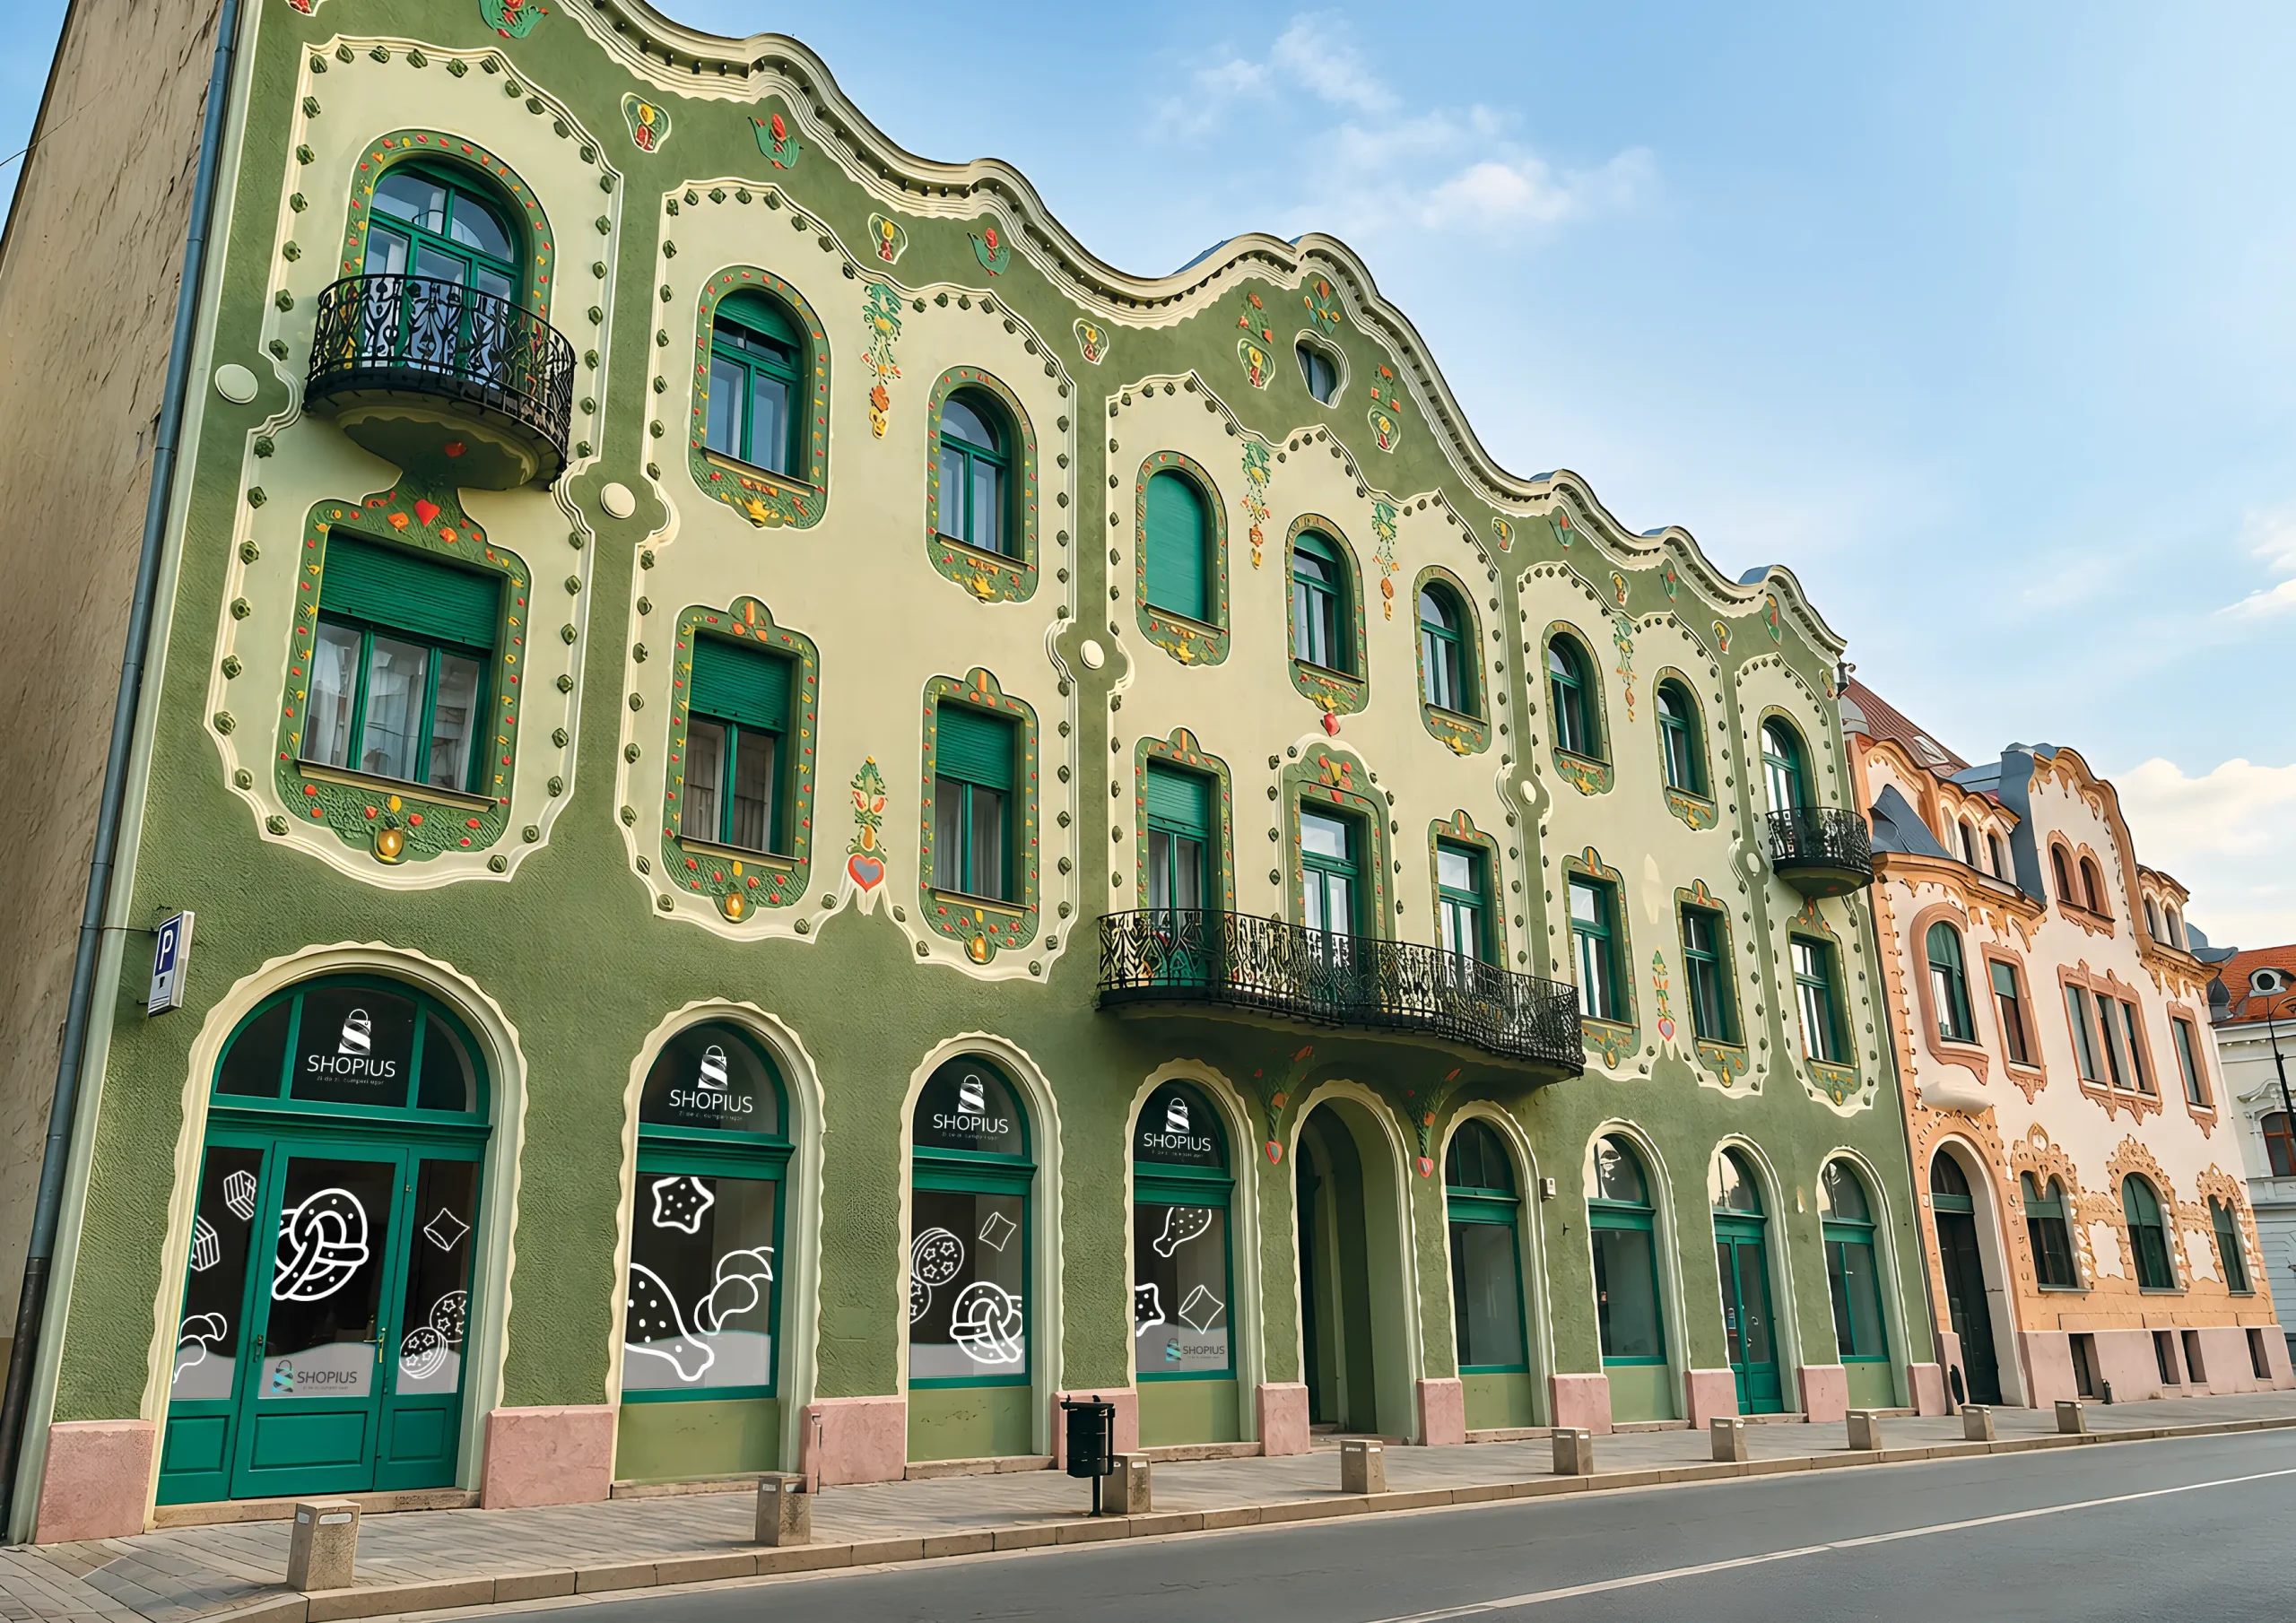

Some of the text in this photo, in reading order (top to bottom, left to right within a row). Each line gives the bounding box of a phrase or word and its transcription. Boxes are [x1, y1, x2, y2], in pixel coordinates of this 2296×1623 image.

[159, 929, 174, 970] P
[307, 1055, 396, 1078] SHOPIUS
[668, 1089, 753, 1113] SHOPIUS
[933, 1114, 1009, 1133] SHOPIUS
[1144, 1133, 1212, 1151] SHOPIUS
[1182, 1346, 1225, 1355] SHOPIUS
[297, 1371, 358, 1384] SHOPIUS
